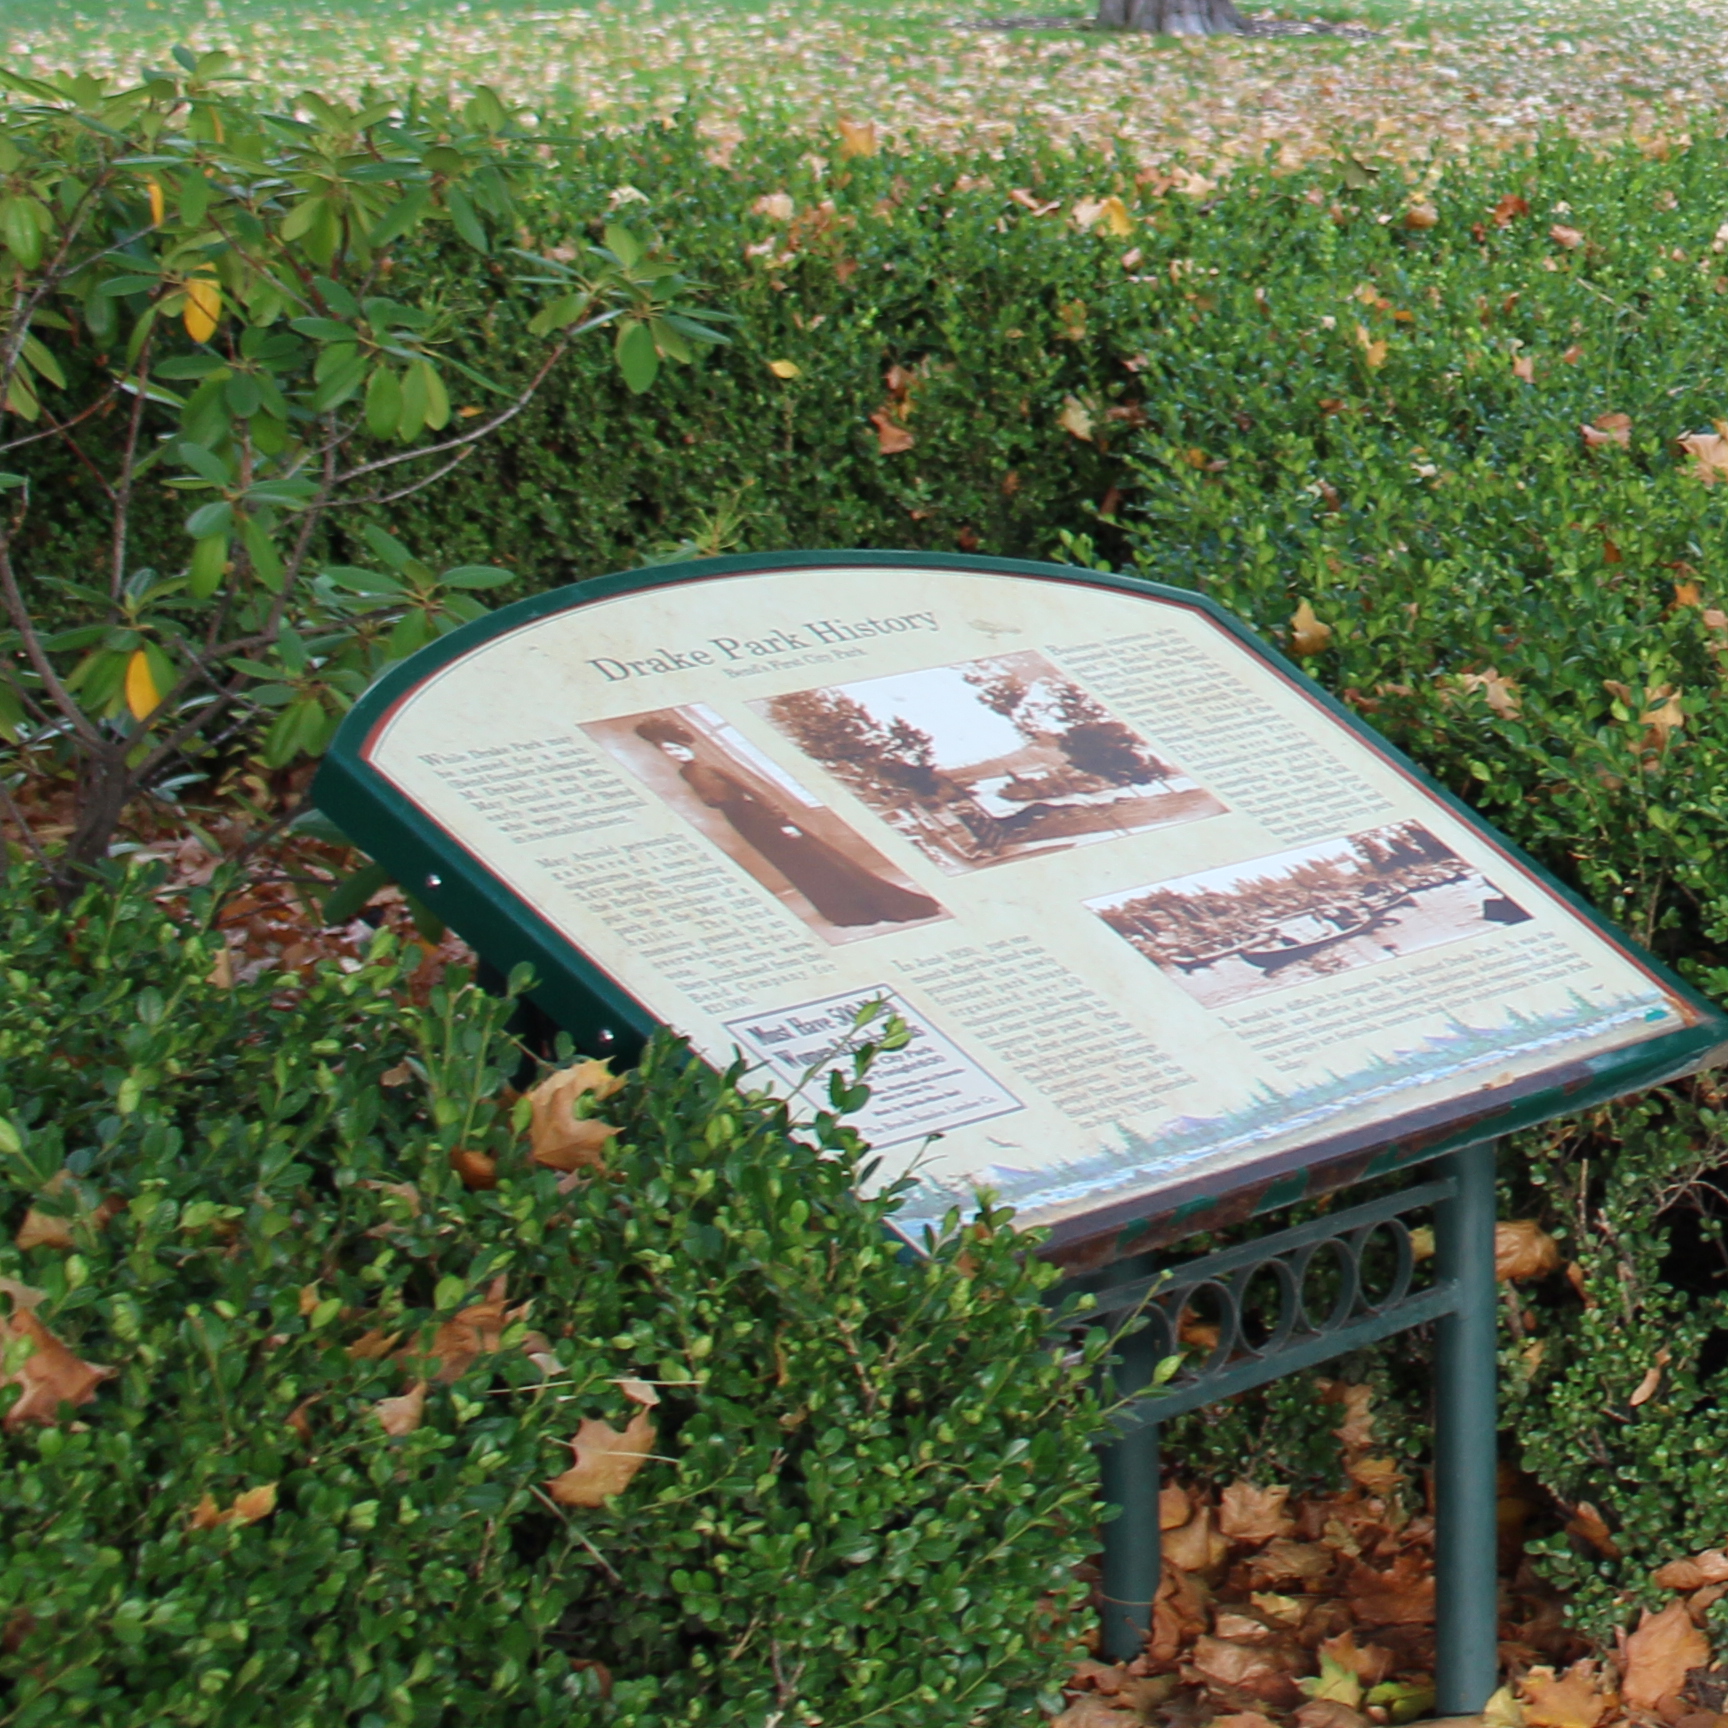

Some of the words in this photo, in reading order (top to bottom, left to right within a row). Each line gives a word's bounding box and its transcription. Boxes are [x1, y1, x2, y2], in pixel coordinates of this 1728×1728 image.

[584, 648, 715, 682] Drake
[708, 630, 812, 660] Park
[802, 611, 940, 644] History
[722, 664, 772, 678] Bend's
[767, 658, 805, 670] First
[801, 654, 835, 664] City
[830, 647, 868, 659] Park
[468, 747, 510, 758] Drake
[510, 741, 545, 750] Park
[695, 920, 729, 929] The
[688, 987, 733, 1002] Bend
[735, 971, 808, 991] Company
[746, 1024, 797, 1045] Must
[786, 1017, 837, 1036] Have
[903, 1046, 936, 1059] Park
